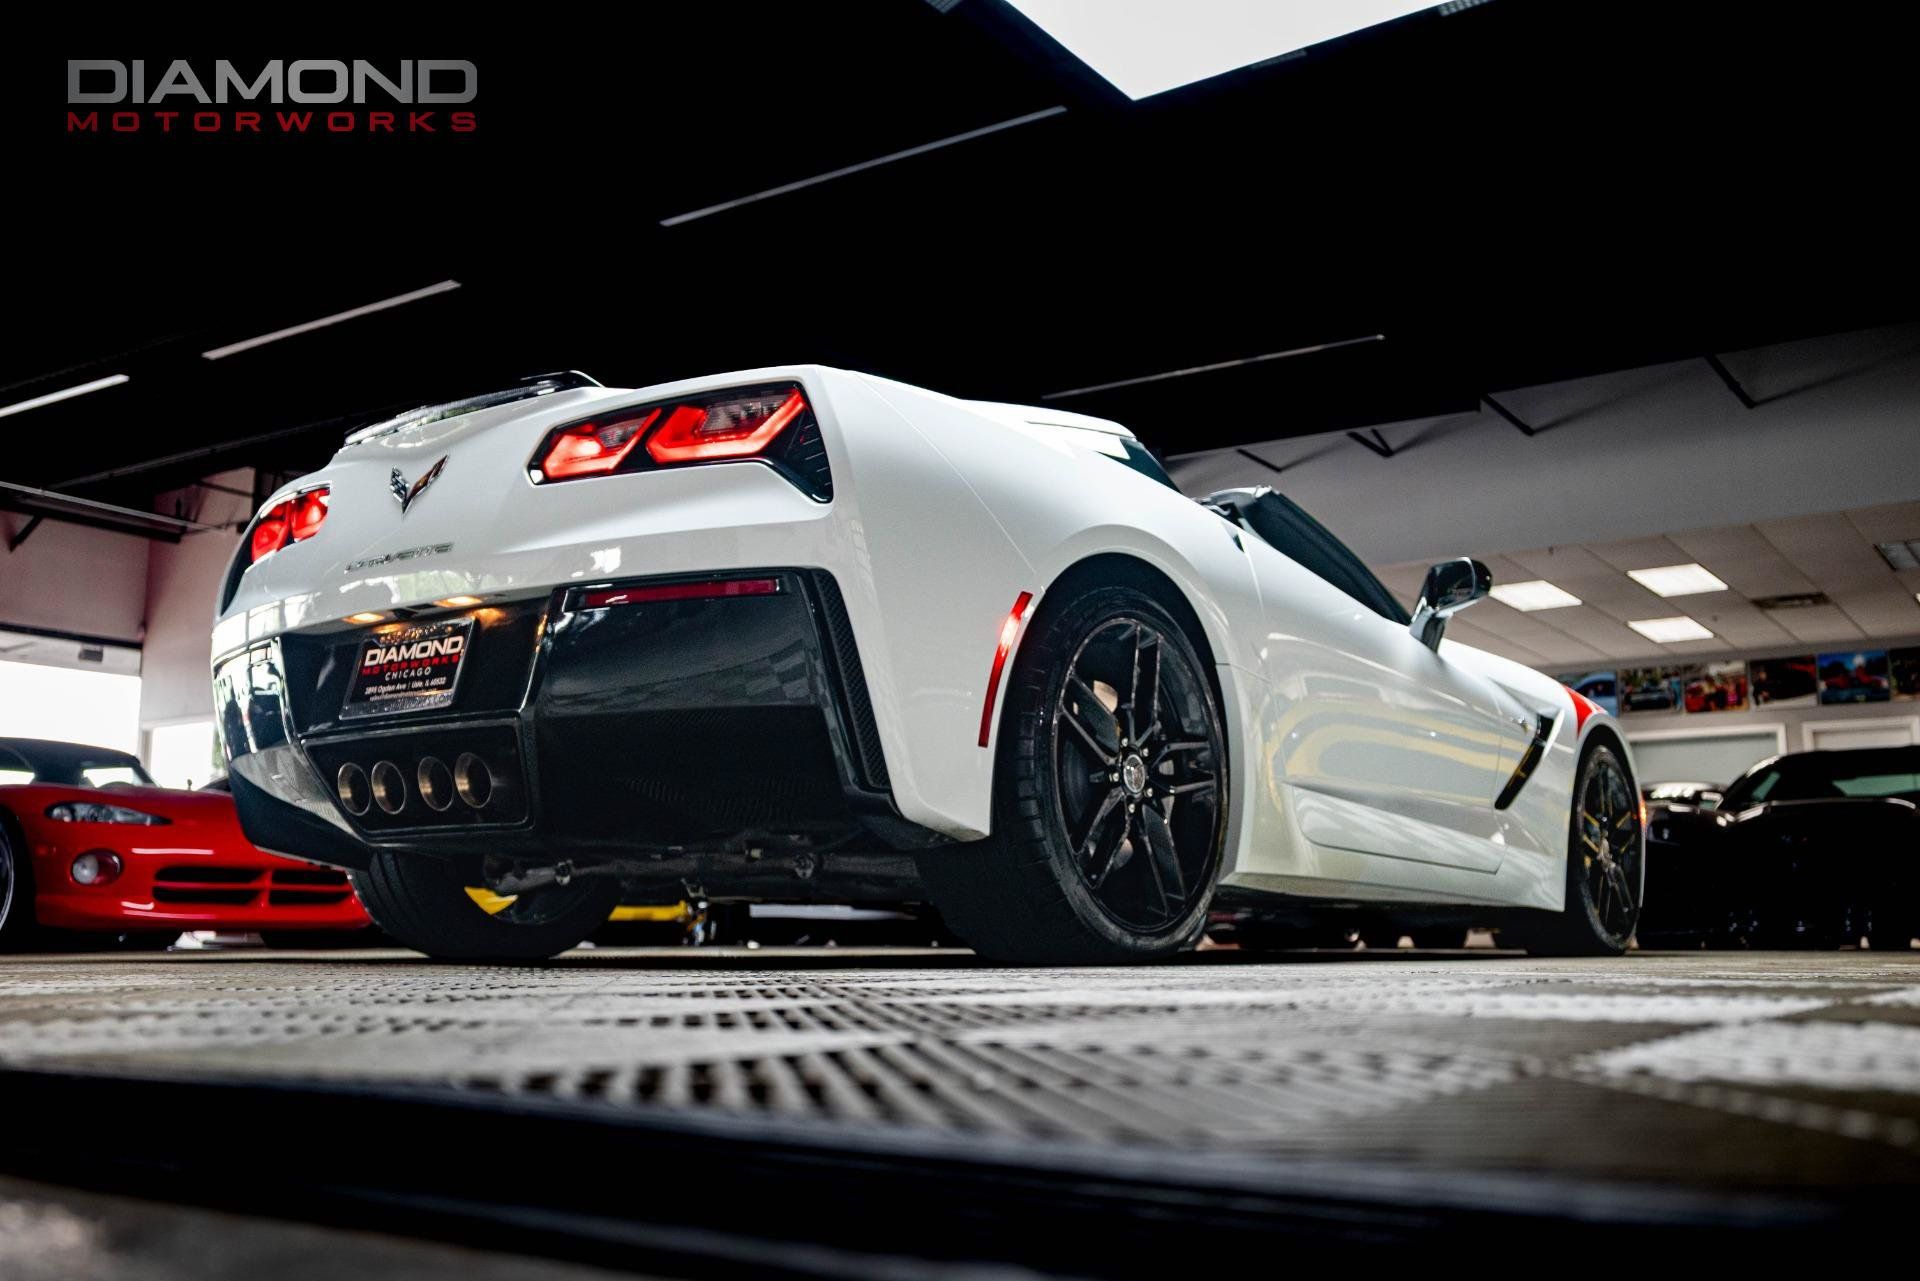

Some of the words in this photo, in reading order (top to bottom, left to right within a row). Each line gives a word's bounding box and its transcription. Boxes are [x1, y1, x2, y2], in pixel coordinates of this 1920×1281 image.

[364, 636, 464, 666] DIAMOND
[361, 654, 460, 675] MOTORWORKS
[385, 666, 431, 680] CHICAGO
